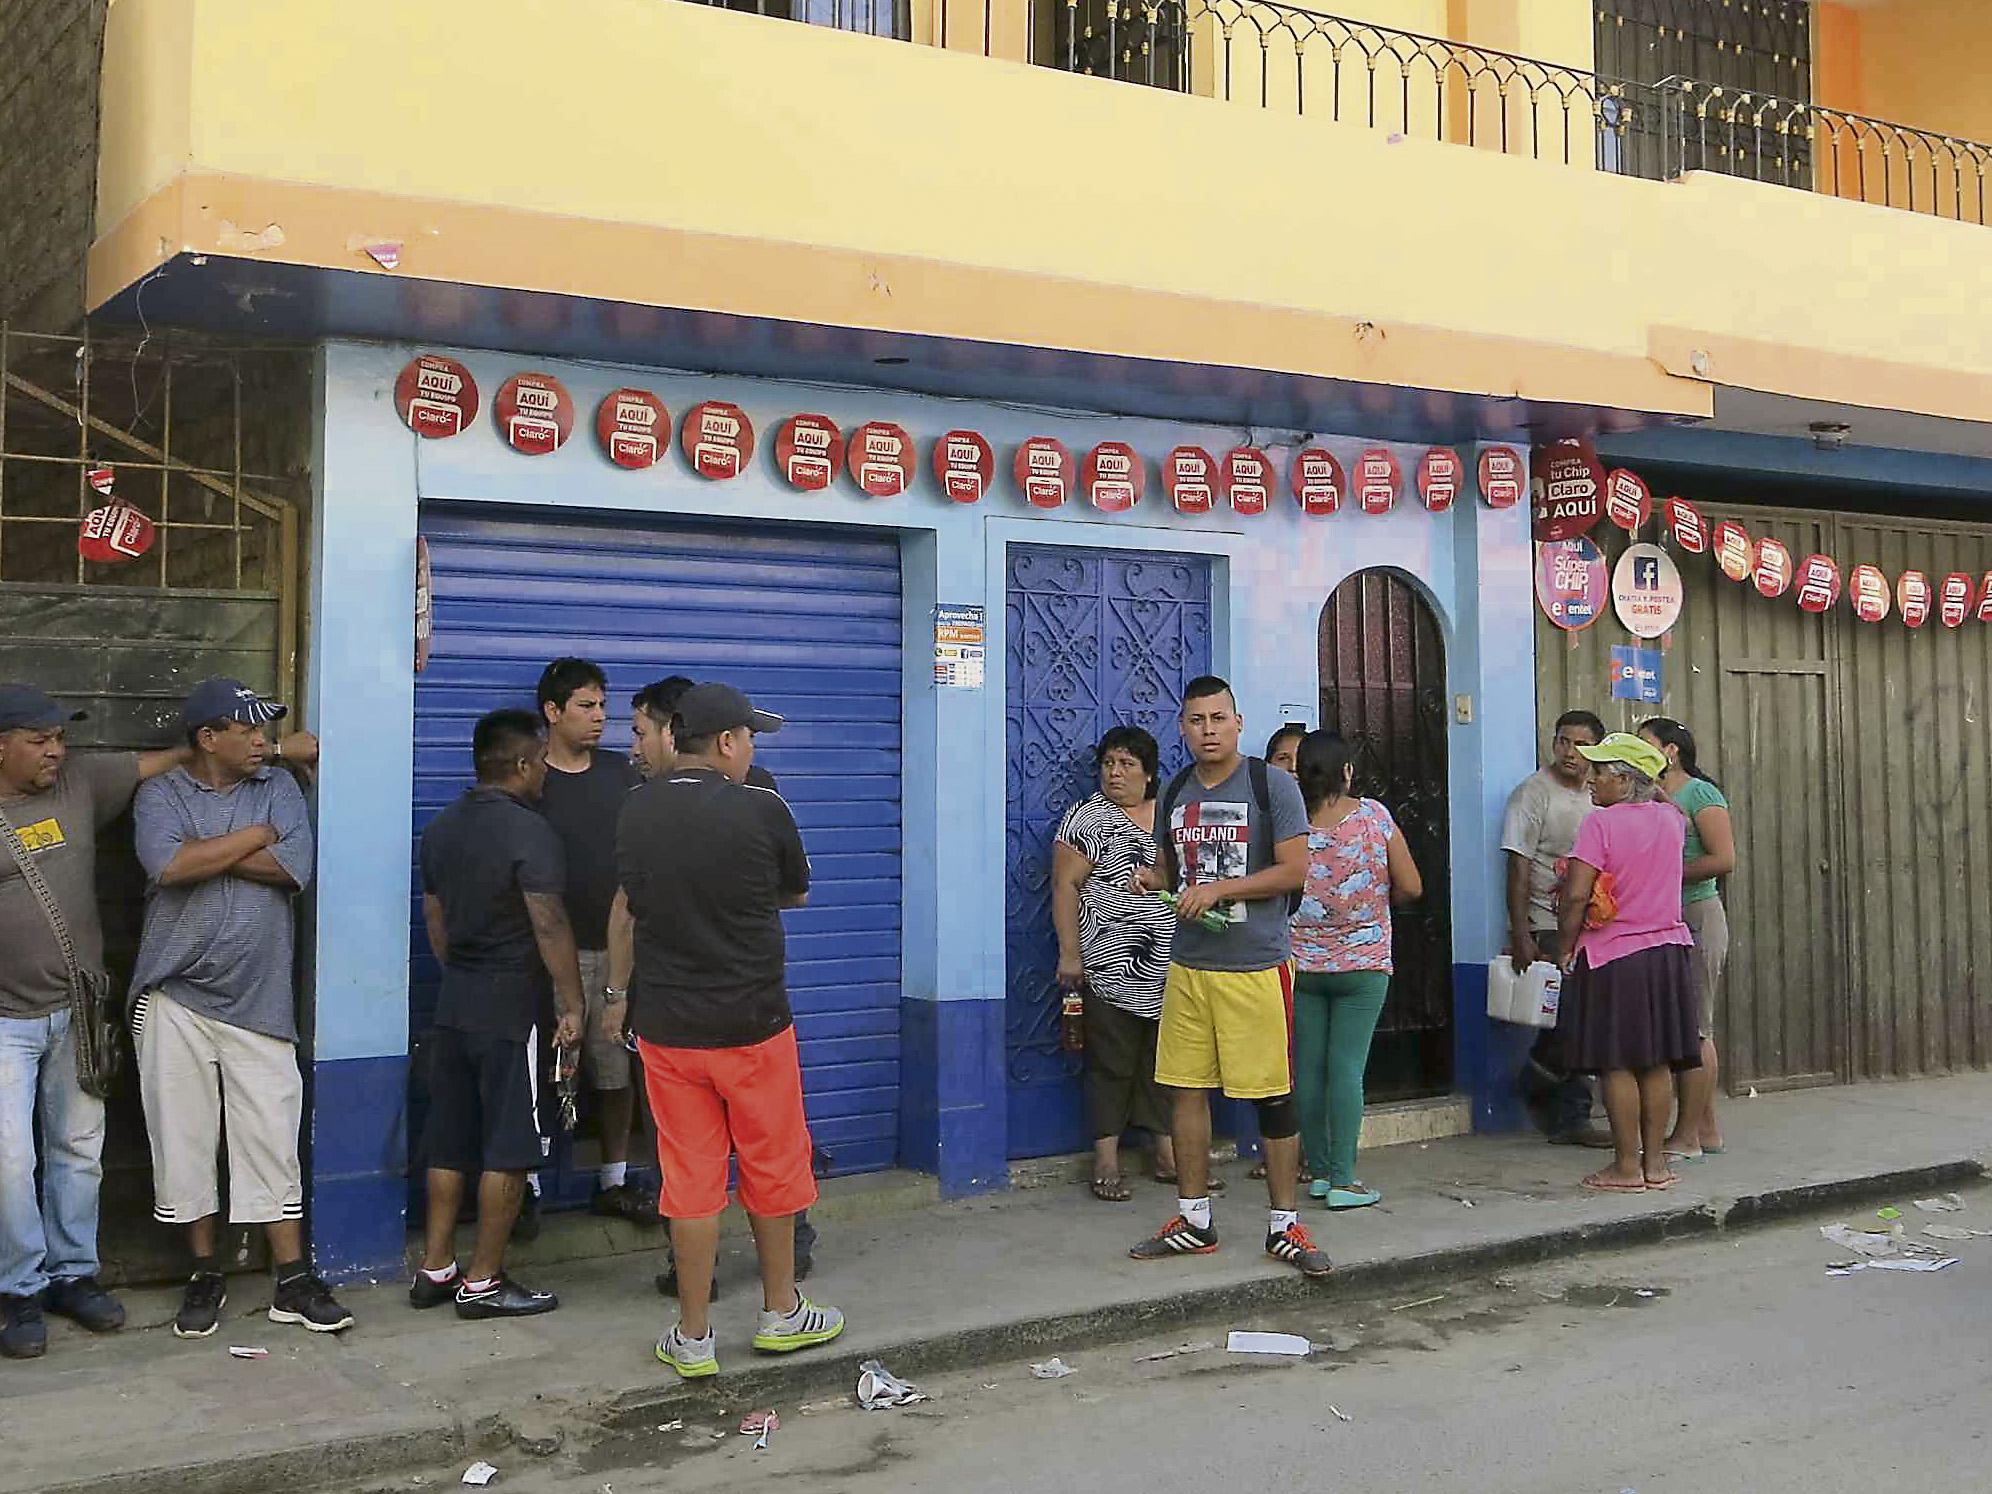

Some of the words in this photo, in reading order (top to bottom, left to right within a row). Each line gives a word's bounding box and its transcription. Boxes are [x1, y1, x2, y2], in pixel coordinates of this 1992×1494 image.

[421, 375, 453, 391] AQUÍ
[520, 391, 549, 407] AQUÍ
[418, 410, 450, 424] Claro
[620, 408, 648, 422] AQUÍ
[519, 426, 549, 440] Claro
[704, 419, 732, 434] AQUÍ
[796, 432, 823, 445] AQUÍ
[618, 442, 647, 455] Claro
[869, 439, 894, 452] AQUÍ
[703, 452, 731, 466] Claro
[950, 447, 975, 460] AQUÍ
[1031, 454, 1054, 466] AQUÍ
[1100, 457, 1123, 470] AQUÍ
[1178, 463, 1201, 474] AQUÍ
[1235, 464, 1256, 475] AQUÍ
[796, 465, 823, 476] Claro
[1563, 466, 1590, 479] Chip
[868, 472, 896, 483] Claro
[1551, 482, 1589, 497] Claro
[1554, 497, 1596, 518] AQUÍ
[1175, 827, 1237, 842] ENGLAND
